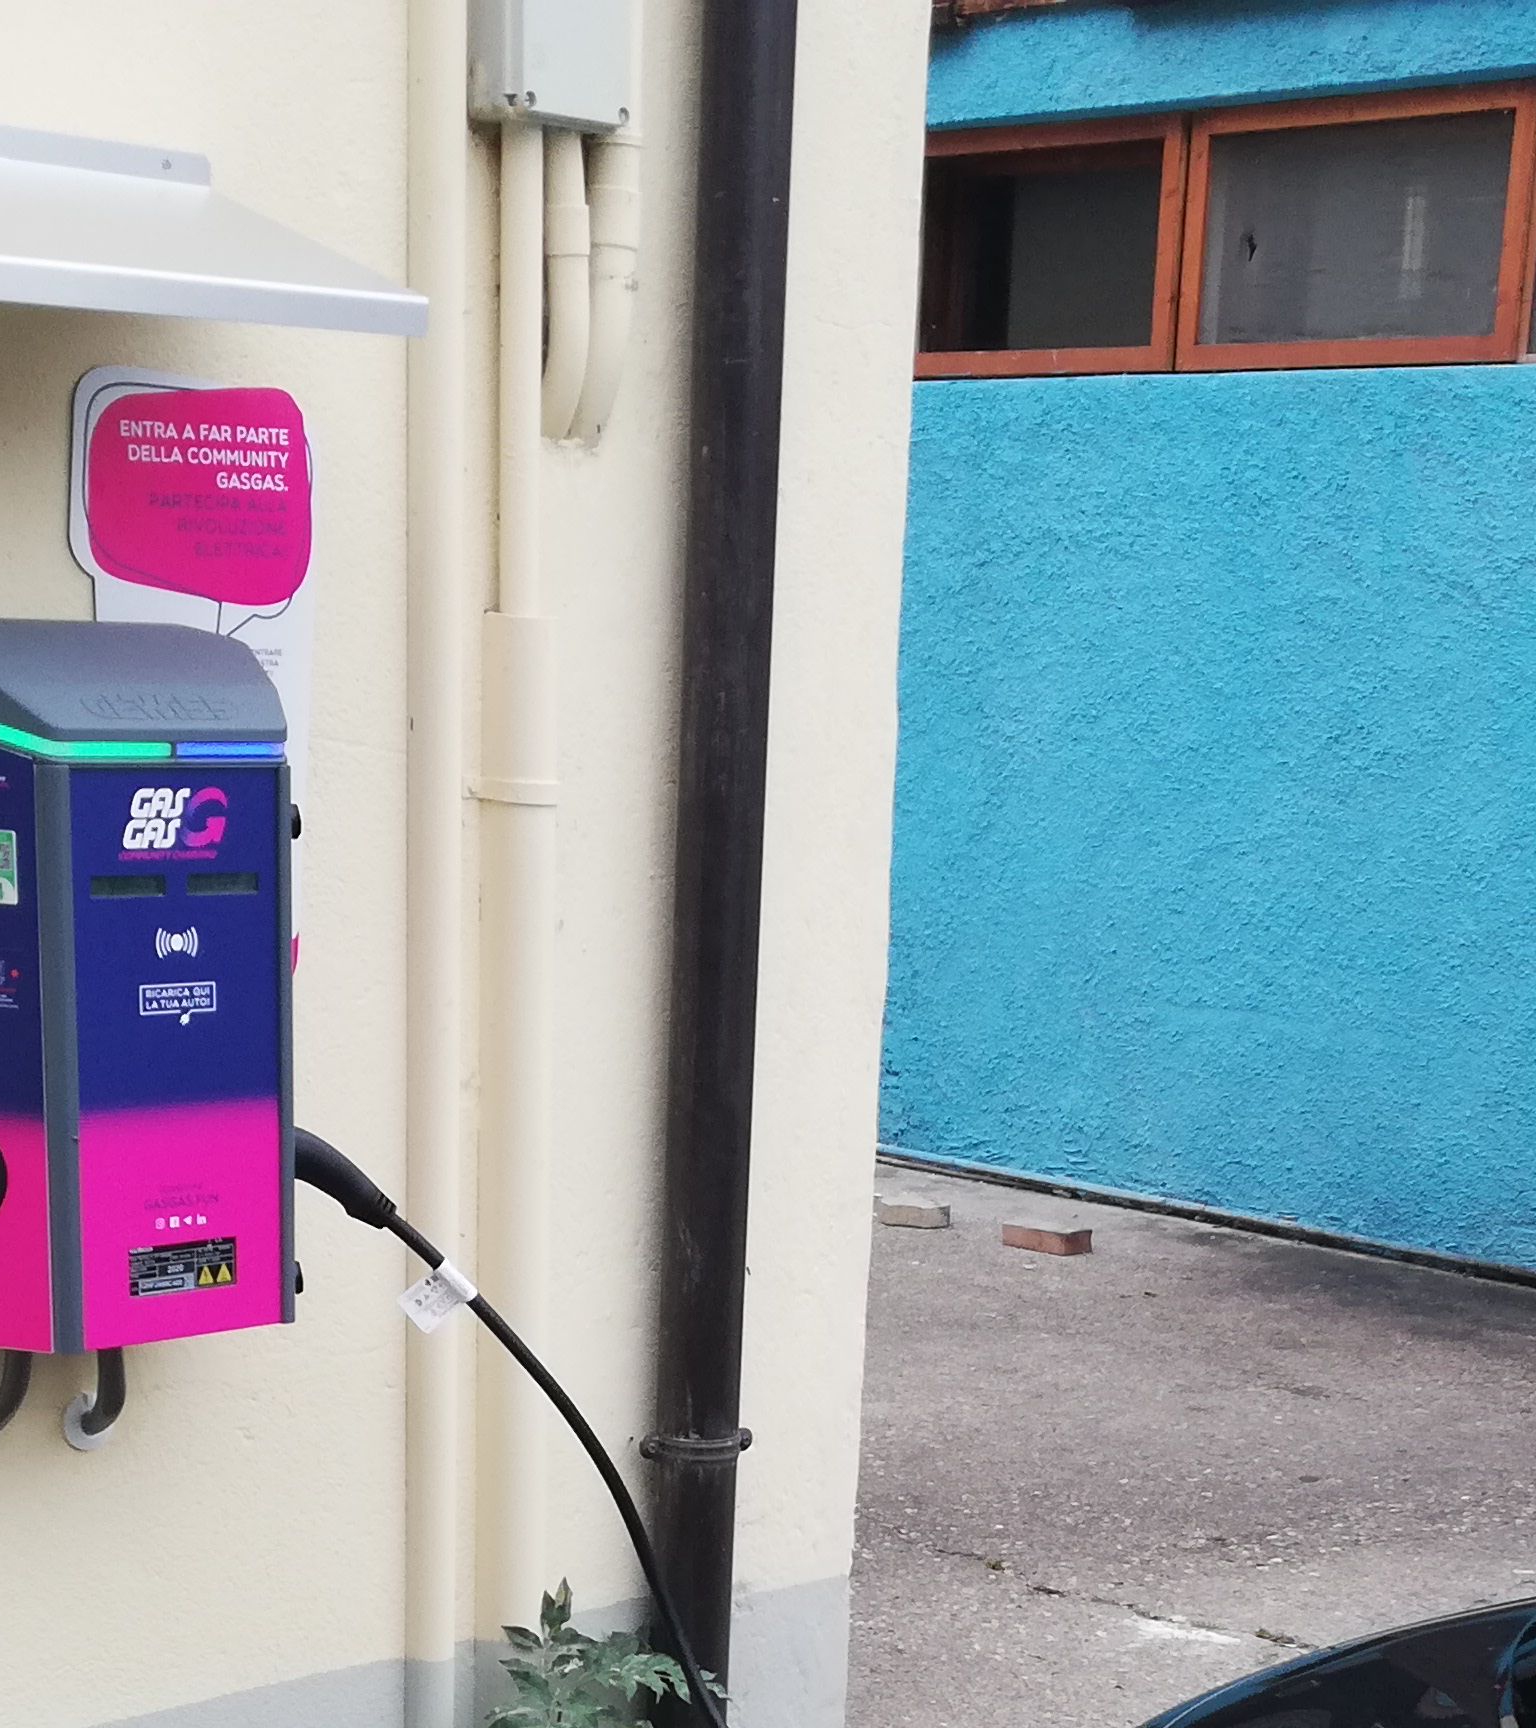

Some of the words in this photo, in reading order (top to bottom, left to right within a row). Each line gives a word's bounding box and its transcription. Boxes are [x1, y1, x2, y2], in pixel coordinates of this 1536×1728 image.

[119, 419, 178, 440] ENTRA
[182, 423, 195, 440] A
[199, 424, 232, 442] FAR
[236, 426, 290, 445] PARTE
[127, 444, 183, 463] DELLA
[187, 447, 289, 468] COMMUNITY
[216, 471, 289, 492] GASGAS.
[130, 787, 191, 818] GAS
[122, 818, 182, 850] GAS
[145, 987, 190, 998] RICARICA
[193, 986, 210, 996] QUI
[145, 1000, 159, 1010] LA
[160, 999, 180, 1009] TUA
